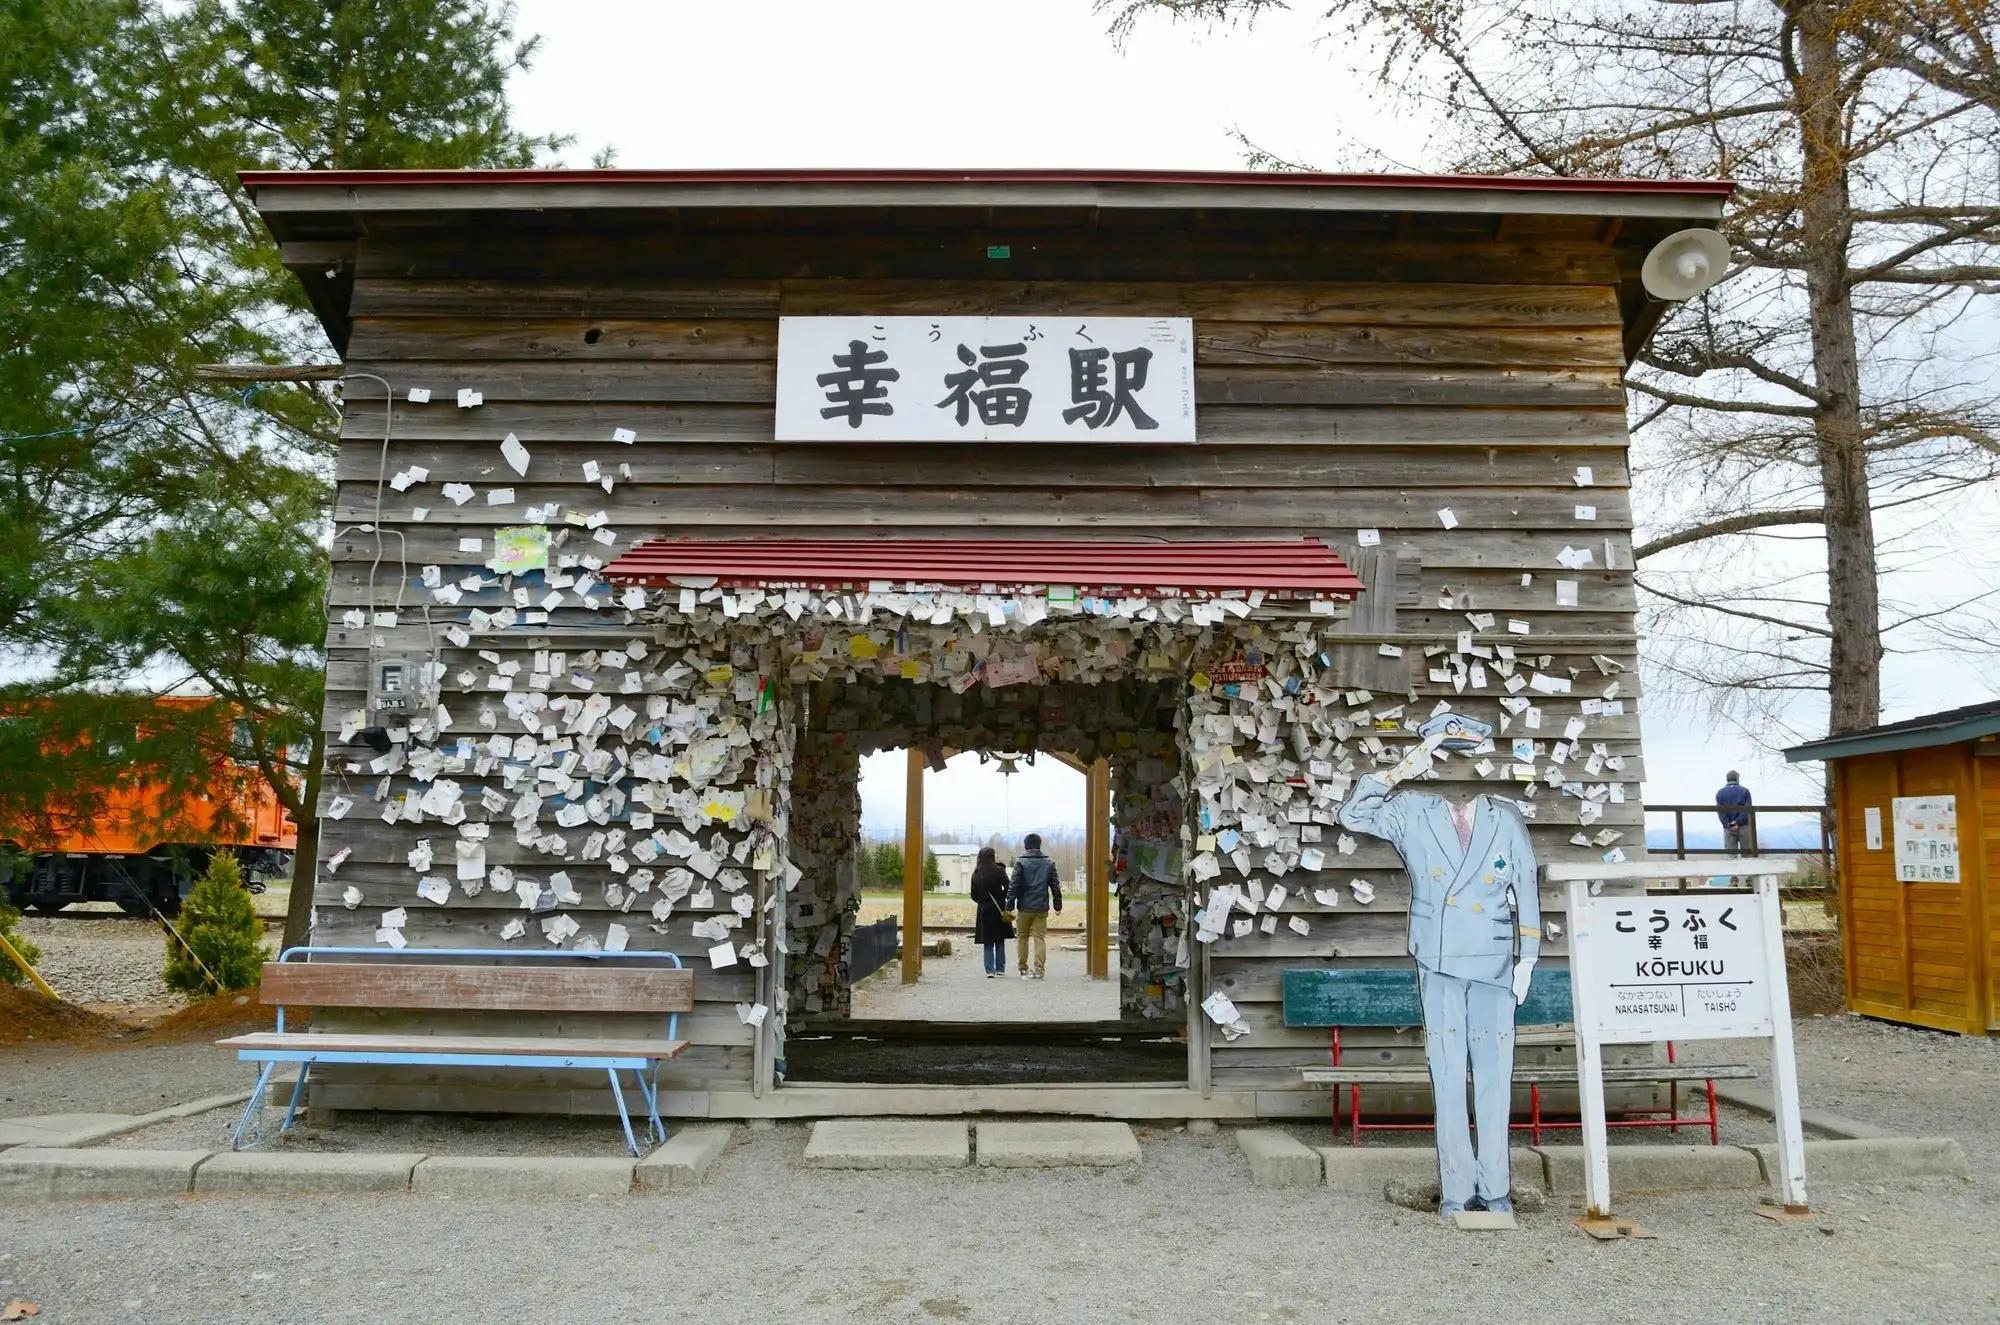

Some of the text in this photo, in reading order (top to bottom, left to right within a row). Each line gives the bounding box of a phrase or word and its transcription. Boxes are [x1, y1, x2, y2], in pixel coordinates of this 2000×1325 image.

[872, 323, 1094, 343] こうふく
[816, 340, 1159, 429] 幸福駅
[1615, 907, 1738, 933] こうふく
[1648, 934, 1709, 950] 幸福
[1618, 989, 1673, 1001] なかさつない
[1697, 988, 1742, 999] たいしょう
[1615, 1003, 1678, 1014] NAKASATSUNAI
